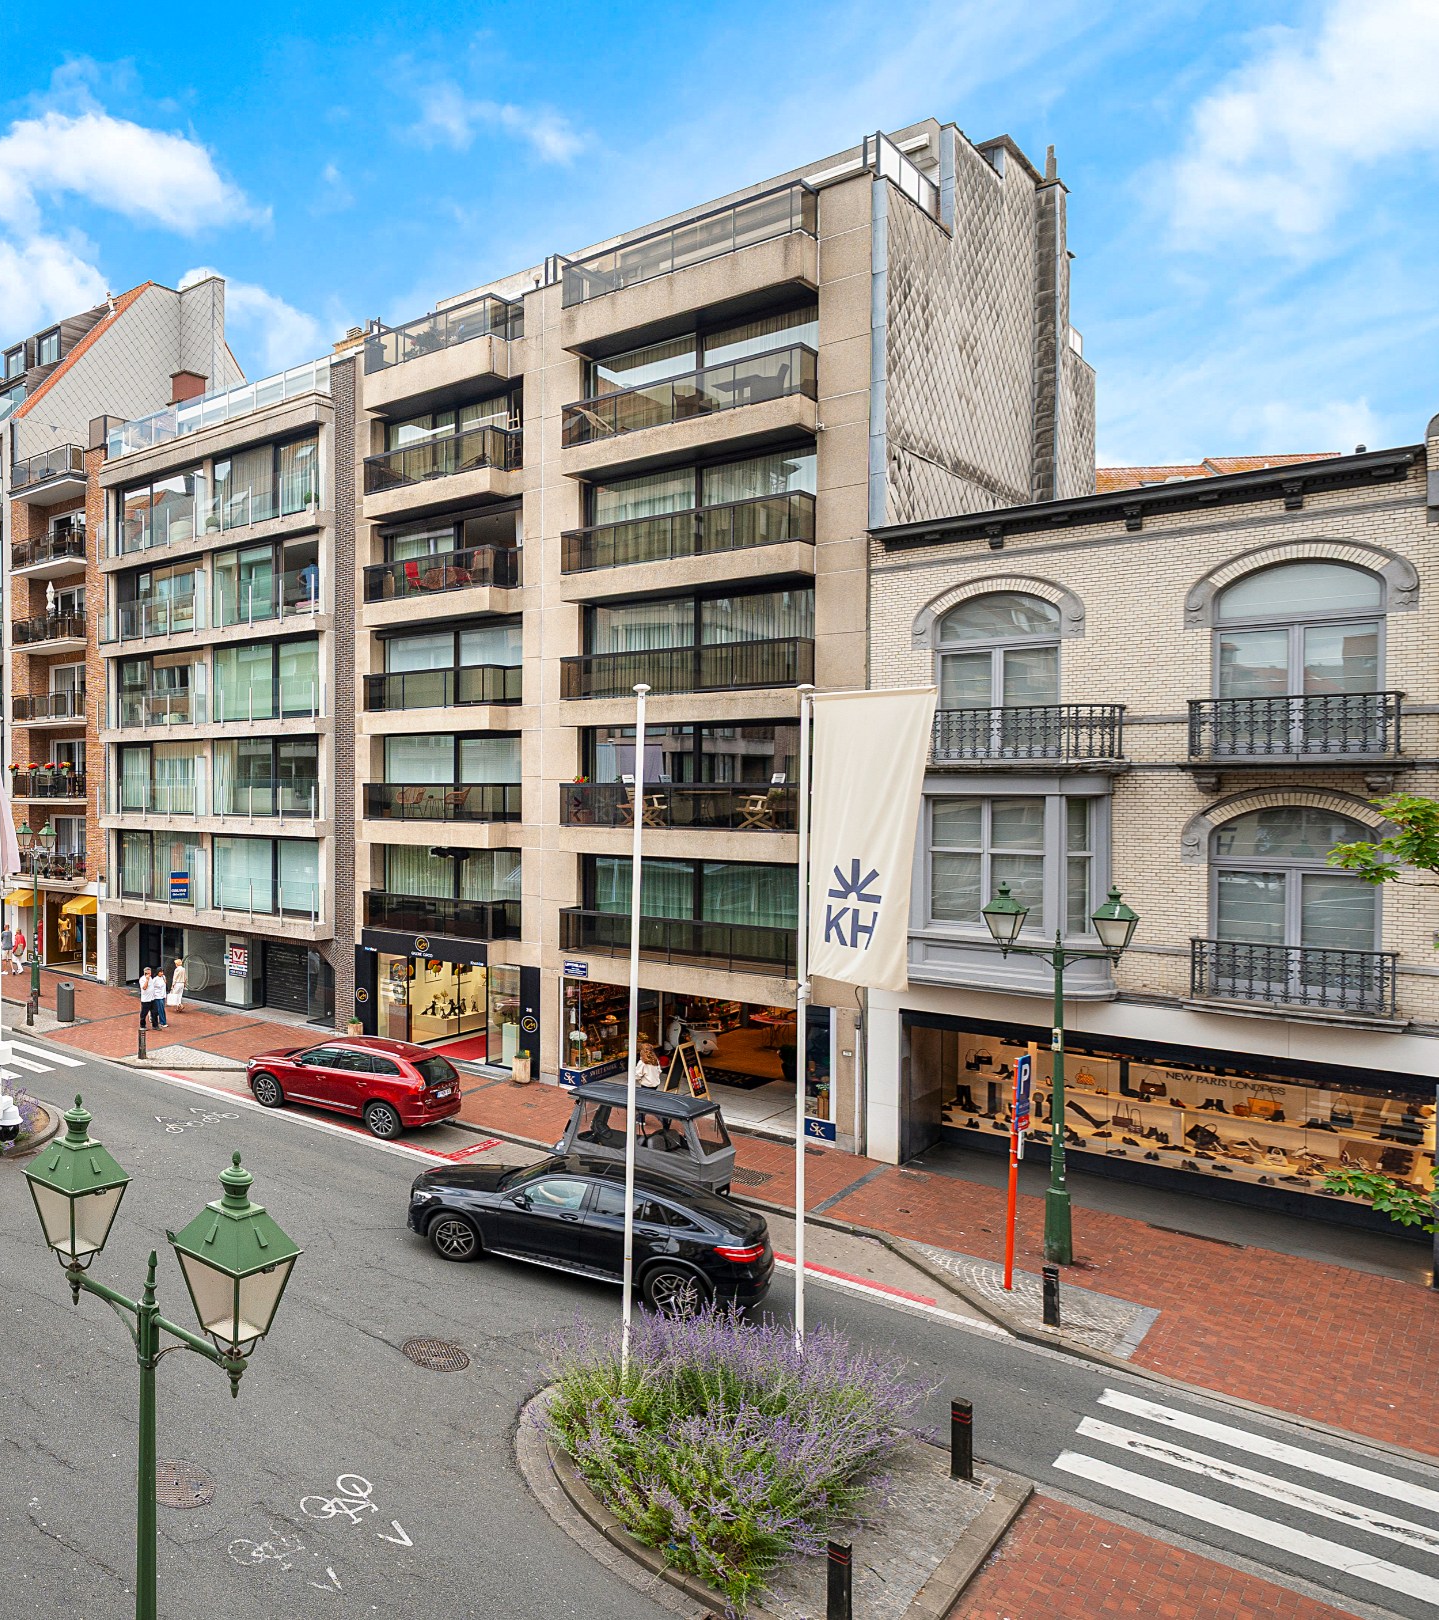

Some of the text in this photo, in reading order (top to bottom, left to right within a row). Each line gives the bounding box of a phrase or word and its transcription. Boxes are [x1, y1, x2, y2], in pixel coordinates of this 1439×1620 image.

[824, 904, 879, 951] KH
[1020, 1063, 1030, 1095] P
[1165, 1071, 1286, 1095] NEW PARIS LONDRES
[809, 1121, 826, 1138] SK
